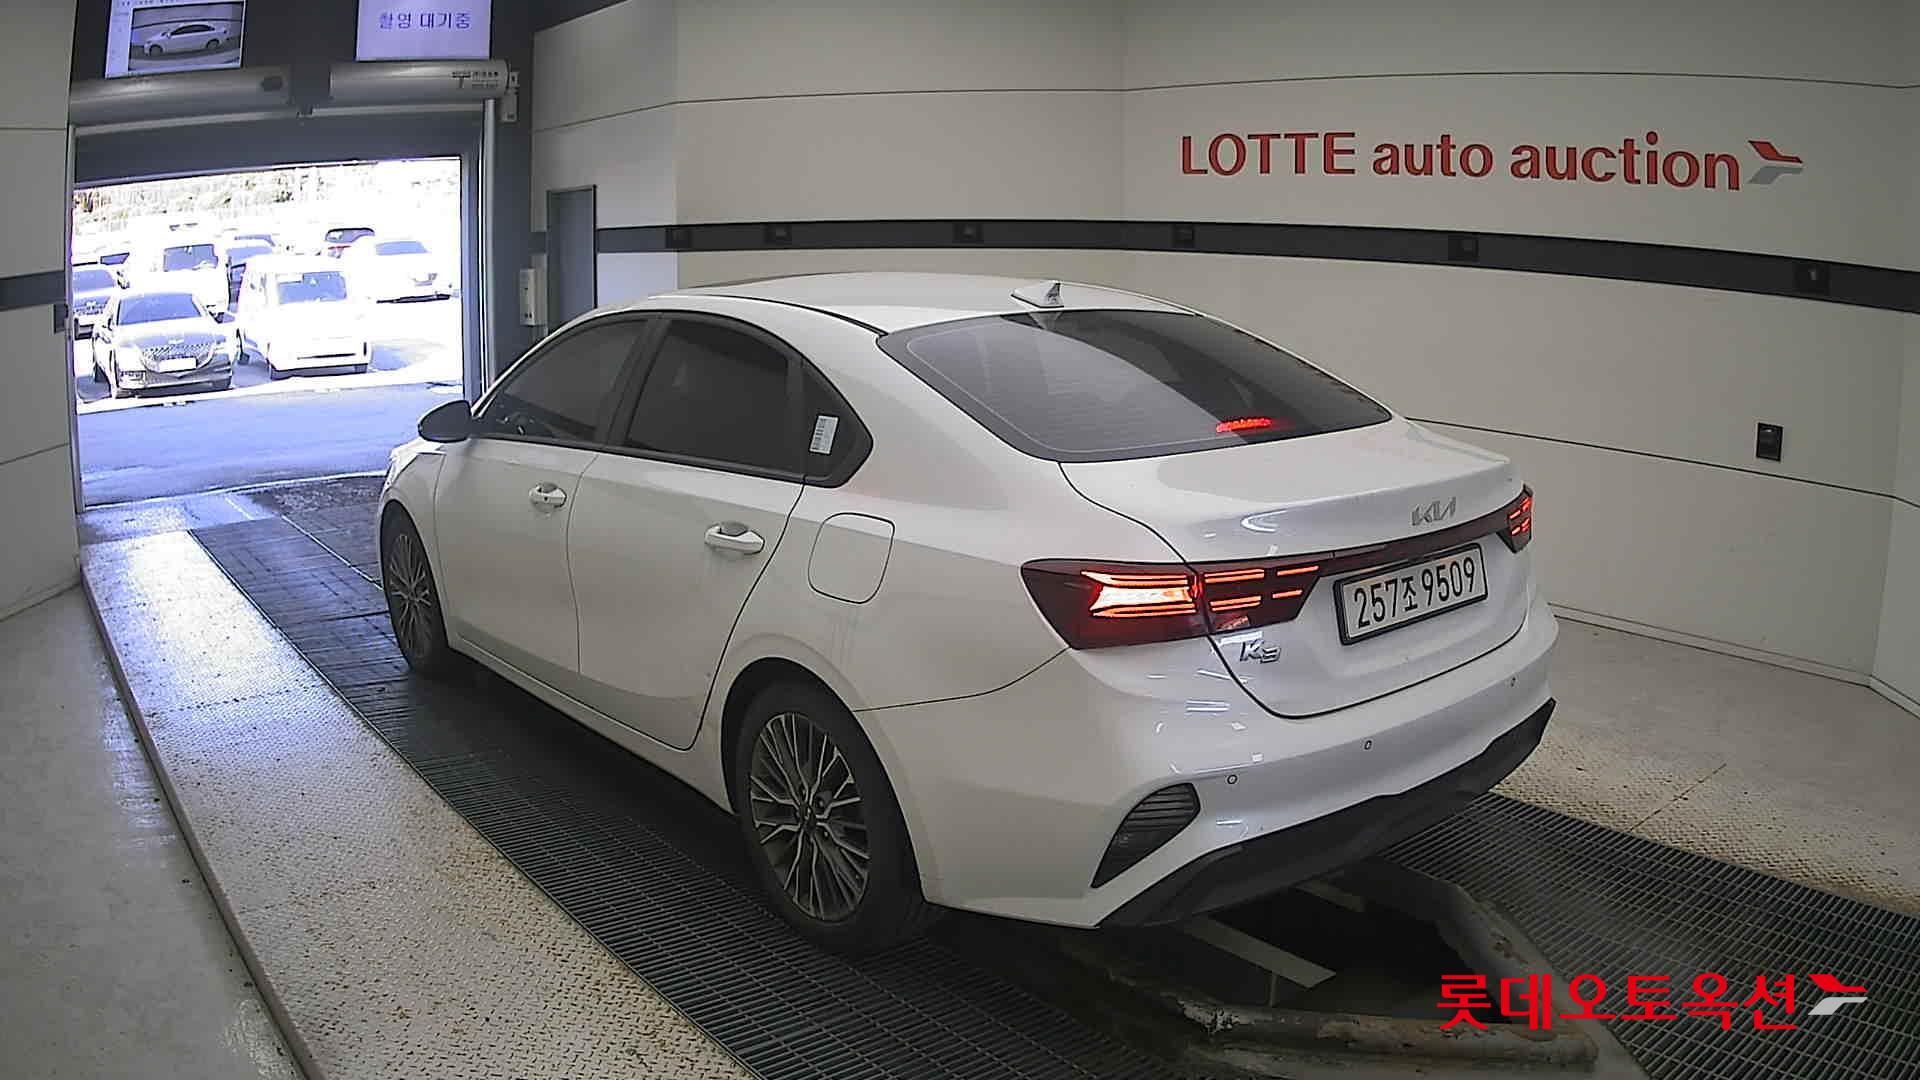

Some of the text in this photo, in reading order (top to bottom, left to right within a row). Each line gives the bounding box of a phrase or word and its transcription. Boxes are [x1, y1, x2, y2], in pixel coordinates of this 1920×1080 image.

[419, 12, 471, 29] 대기중
[1181, 131, 1740, 190] LOTTE auto auction
[1239, 639, 1281, 664] K3
